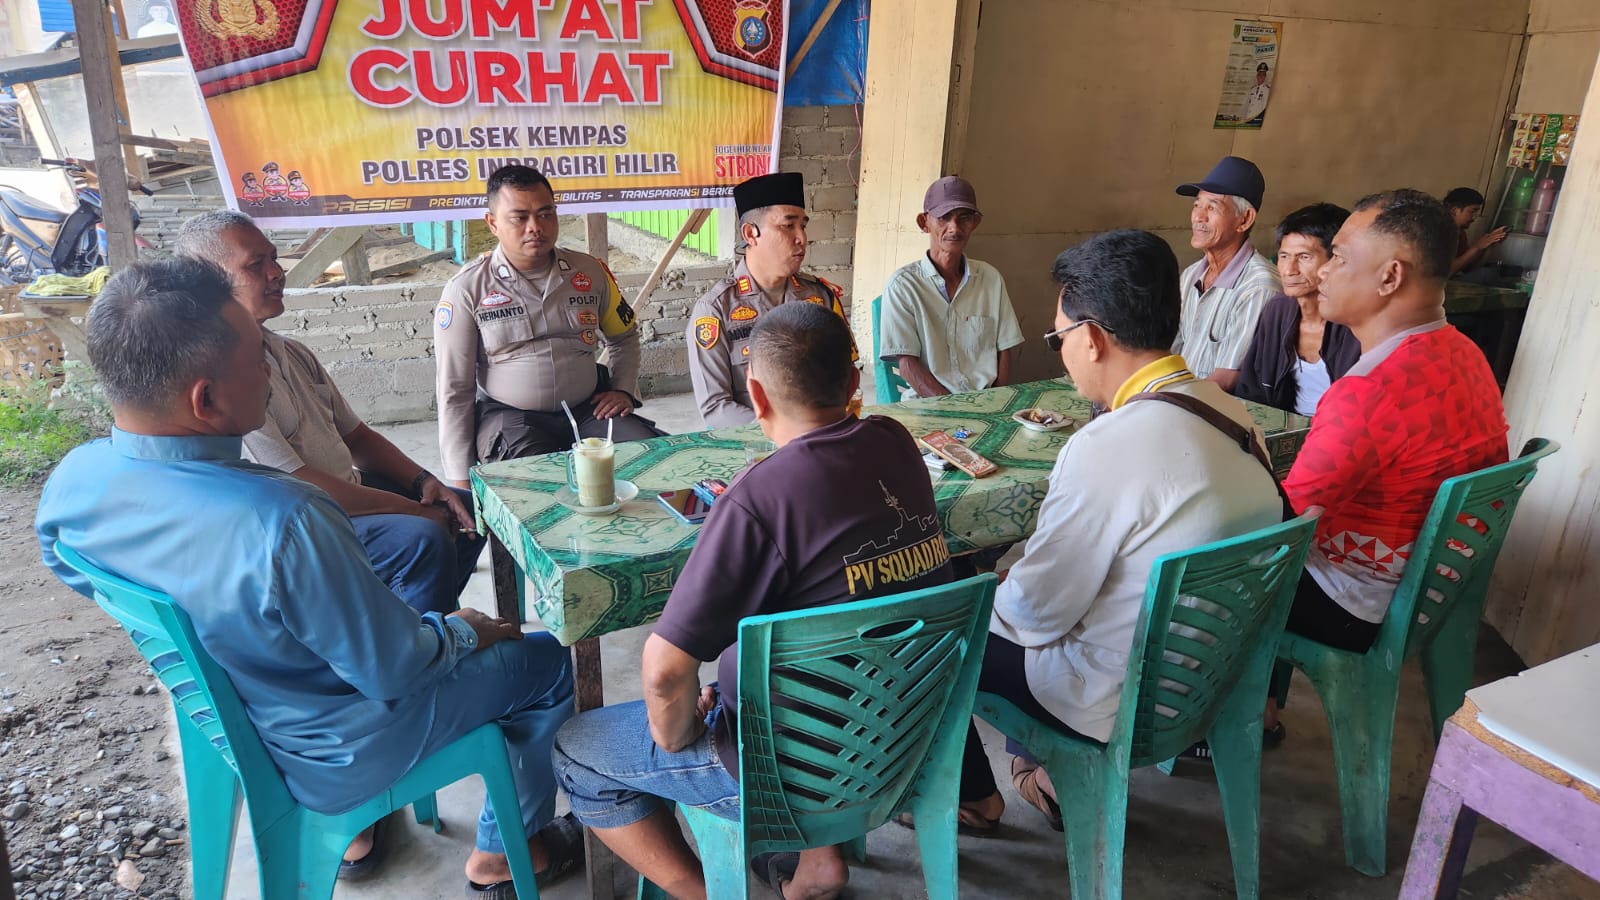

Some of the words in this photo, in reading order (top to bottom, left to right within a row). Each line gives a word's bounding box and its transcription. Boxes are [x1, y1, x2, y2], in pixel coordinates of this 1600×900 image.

[349, 48, 671, 106] CURHAT
[416, 125, 518, 150] POLSEK
[526, 124, 627, 148] KEMPAS
[361, 158, 470, 184] POLRES
[614, 152, 679, 175] HILIR
[428, 196, 489, 208] PREDIKTIF
[553, 190, 602, 202] SIBILITAS
[620, 187, 700, 199] TRANSPARANSI
[701, 186, 735, 197] BERKE
[568, 295, 599, 305] POLRI
[845, 562, 874, 595] PV
[877, 533, 949, 584] SQUADRO
